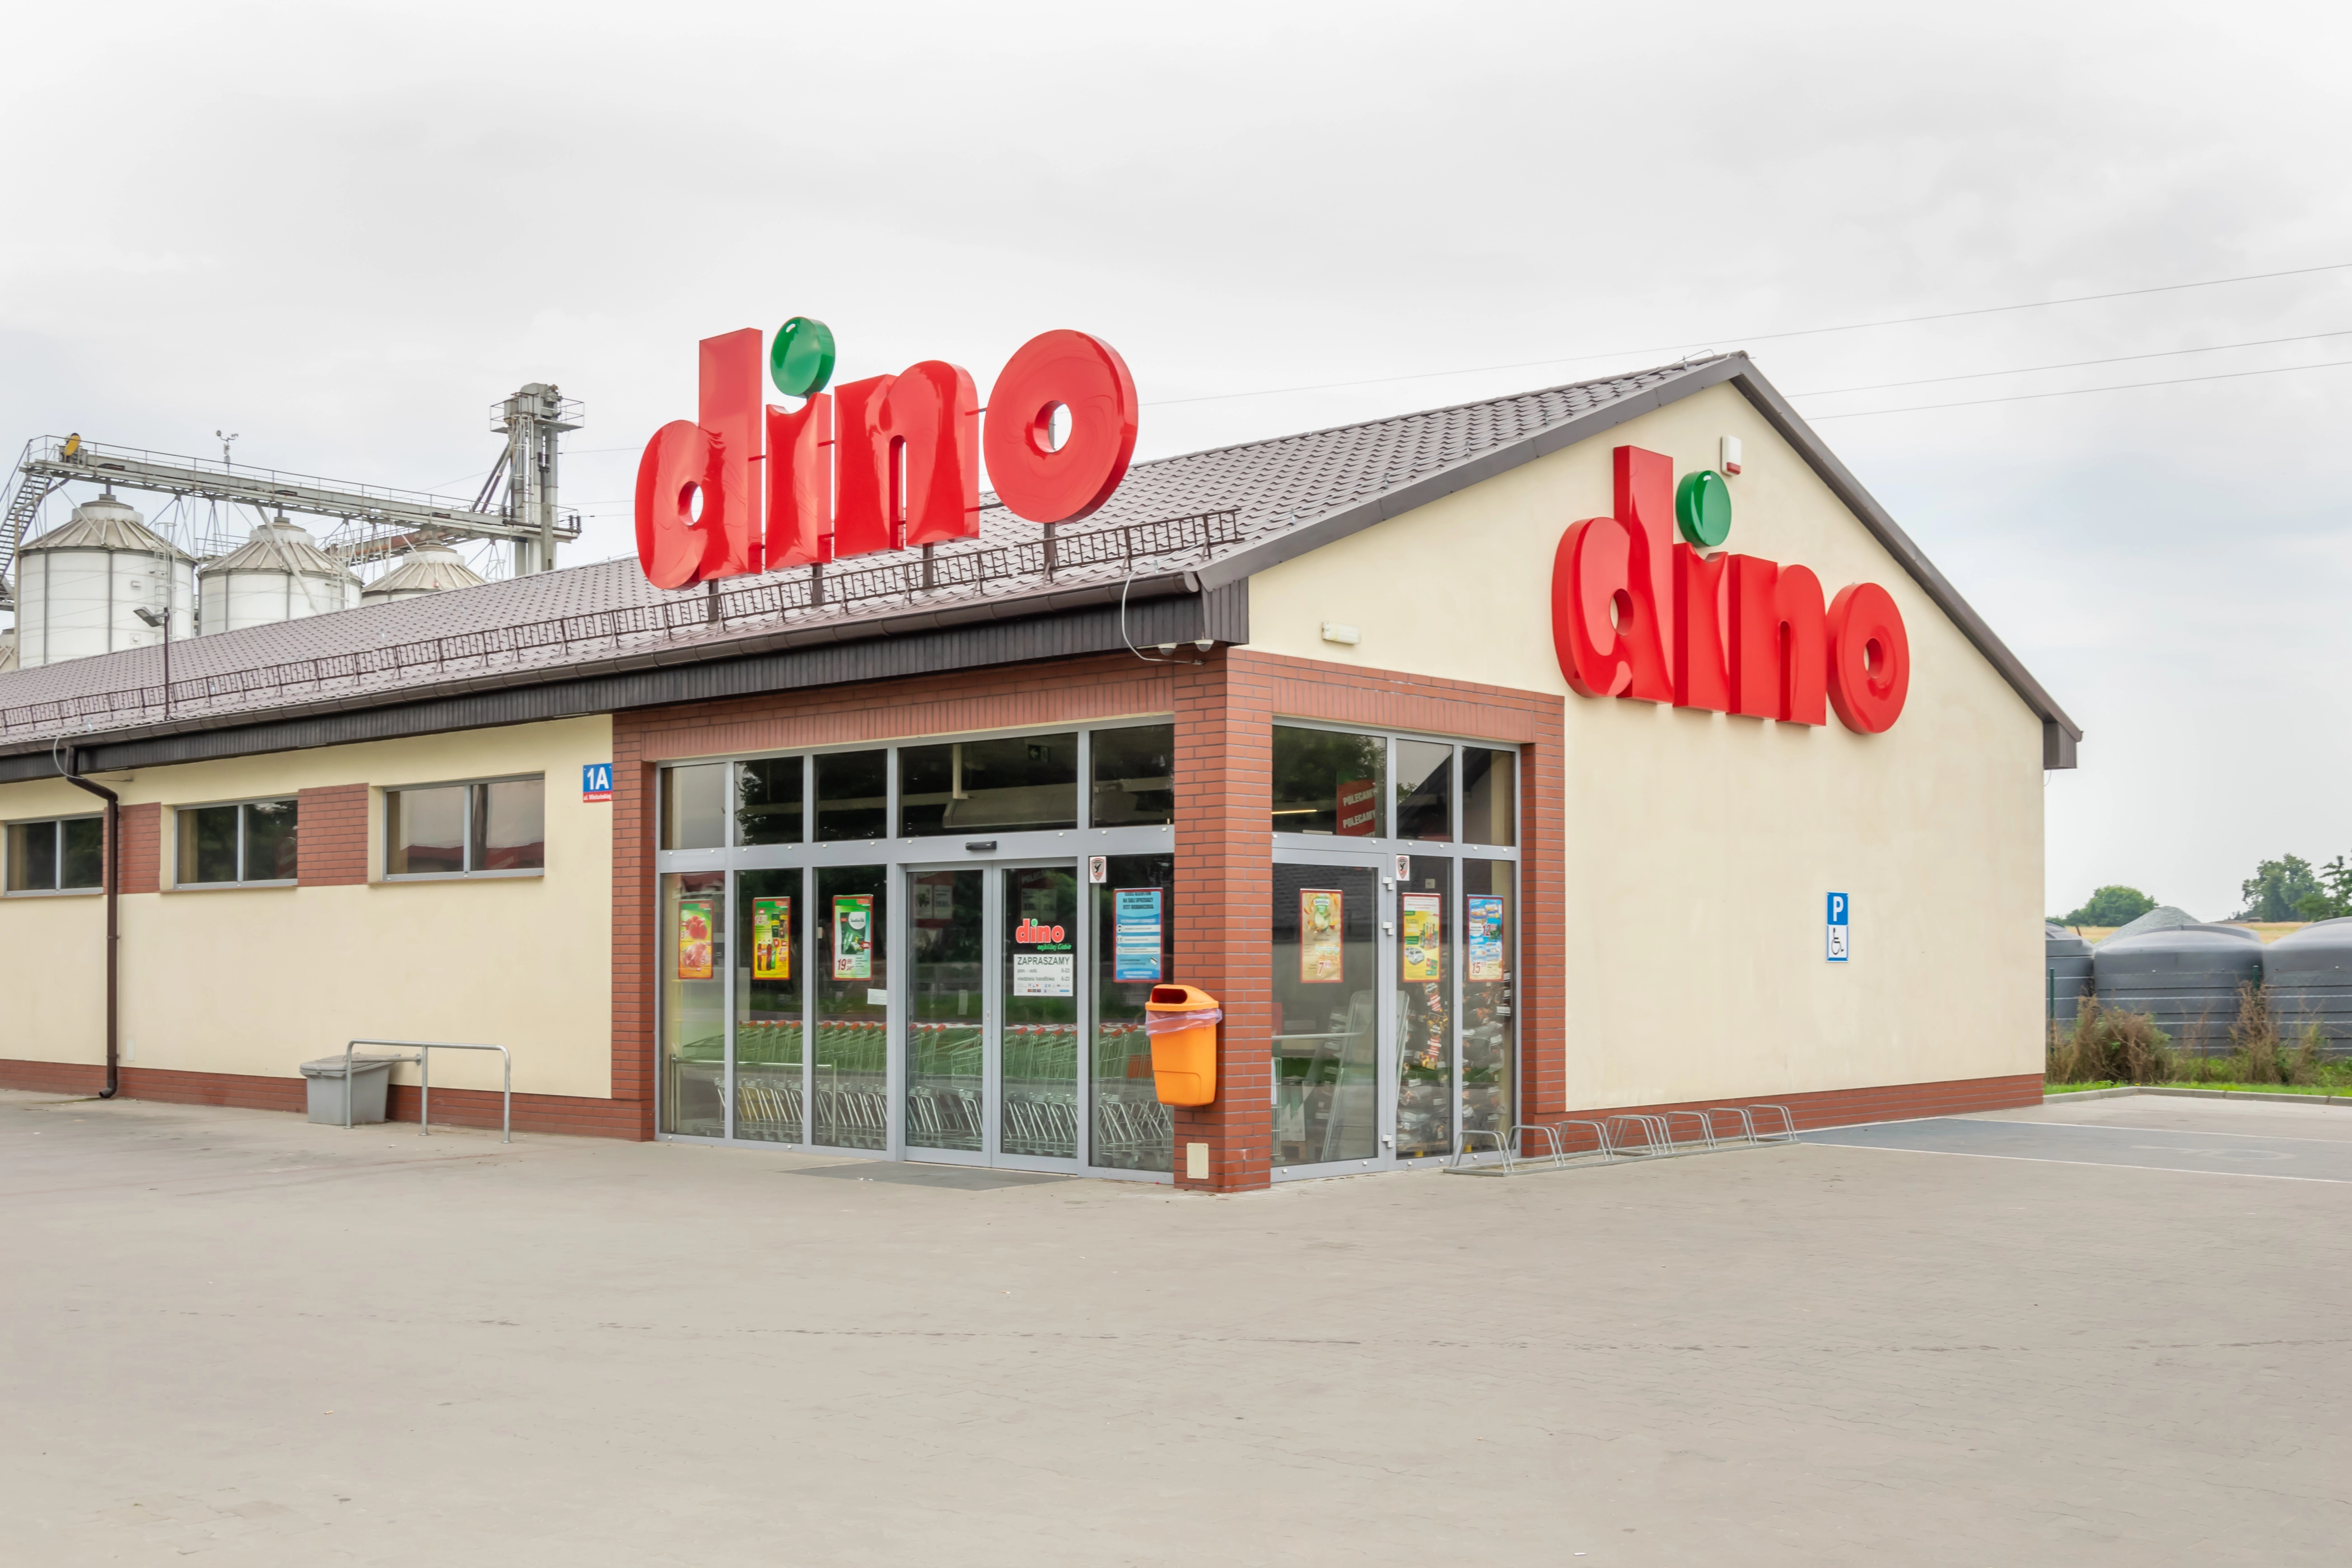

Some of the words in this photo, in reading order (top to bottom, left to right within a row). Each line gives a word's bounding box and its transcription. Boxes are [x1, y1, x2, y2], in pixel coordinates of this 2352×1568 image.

[634, 317, 1138, 590] dino
[1551, 445, 1910, 735] dino
[587, 767, 609, 790] 1A
[1833, 895, 1844, 922] P
[1015, 918, 1065, 944] dino
[837, 958, 847, 970] 19
[1017, 956, 1070, 965] ZAPRASZAMY
[1318, 962, 1324, 976] 7
[1472, 962, 1481, 974] 15
